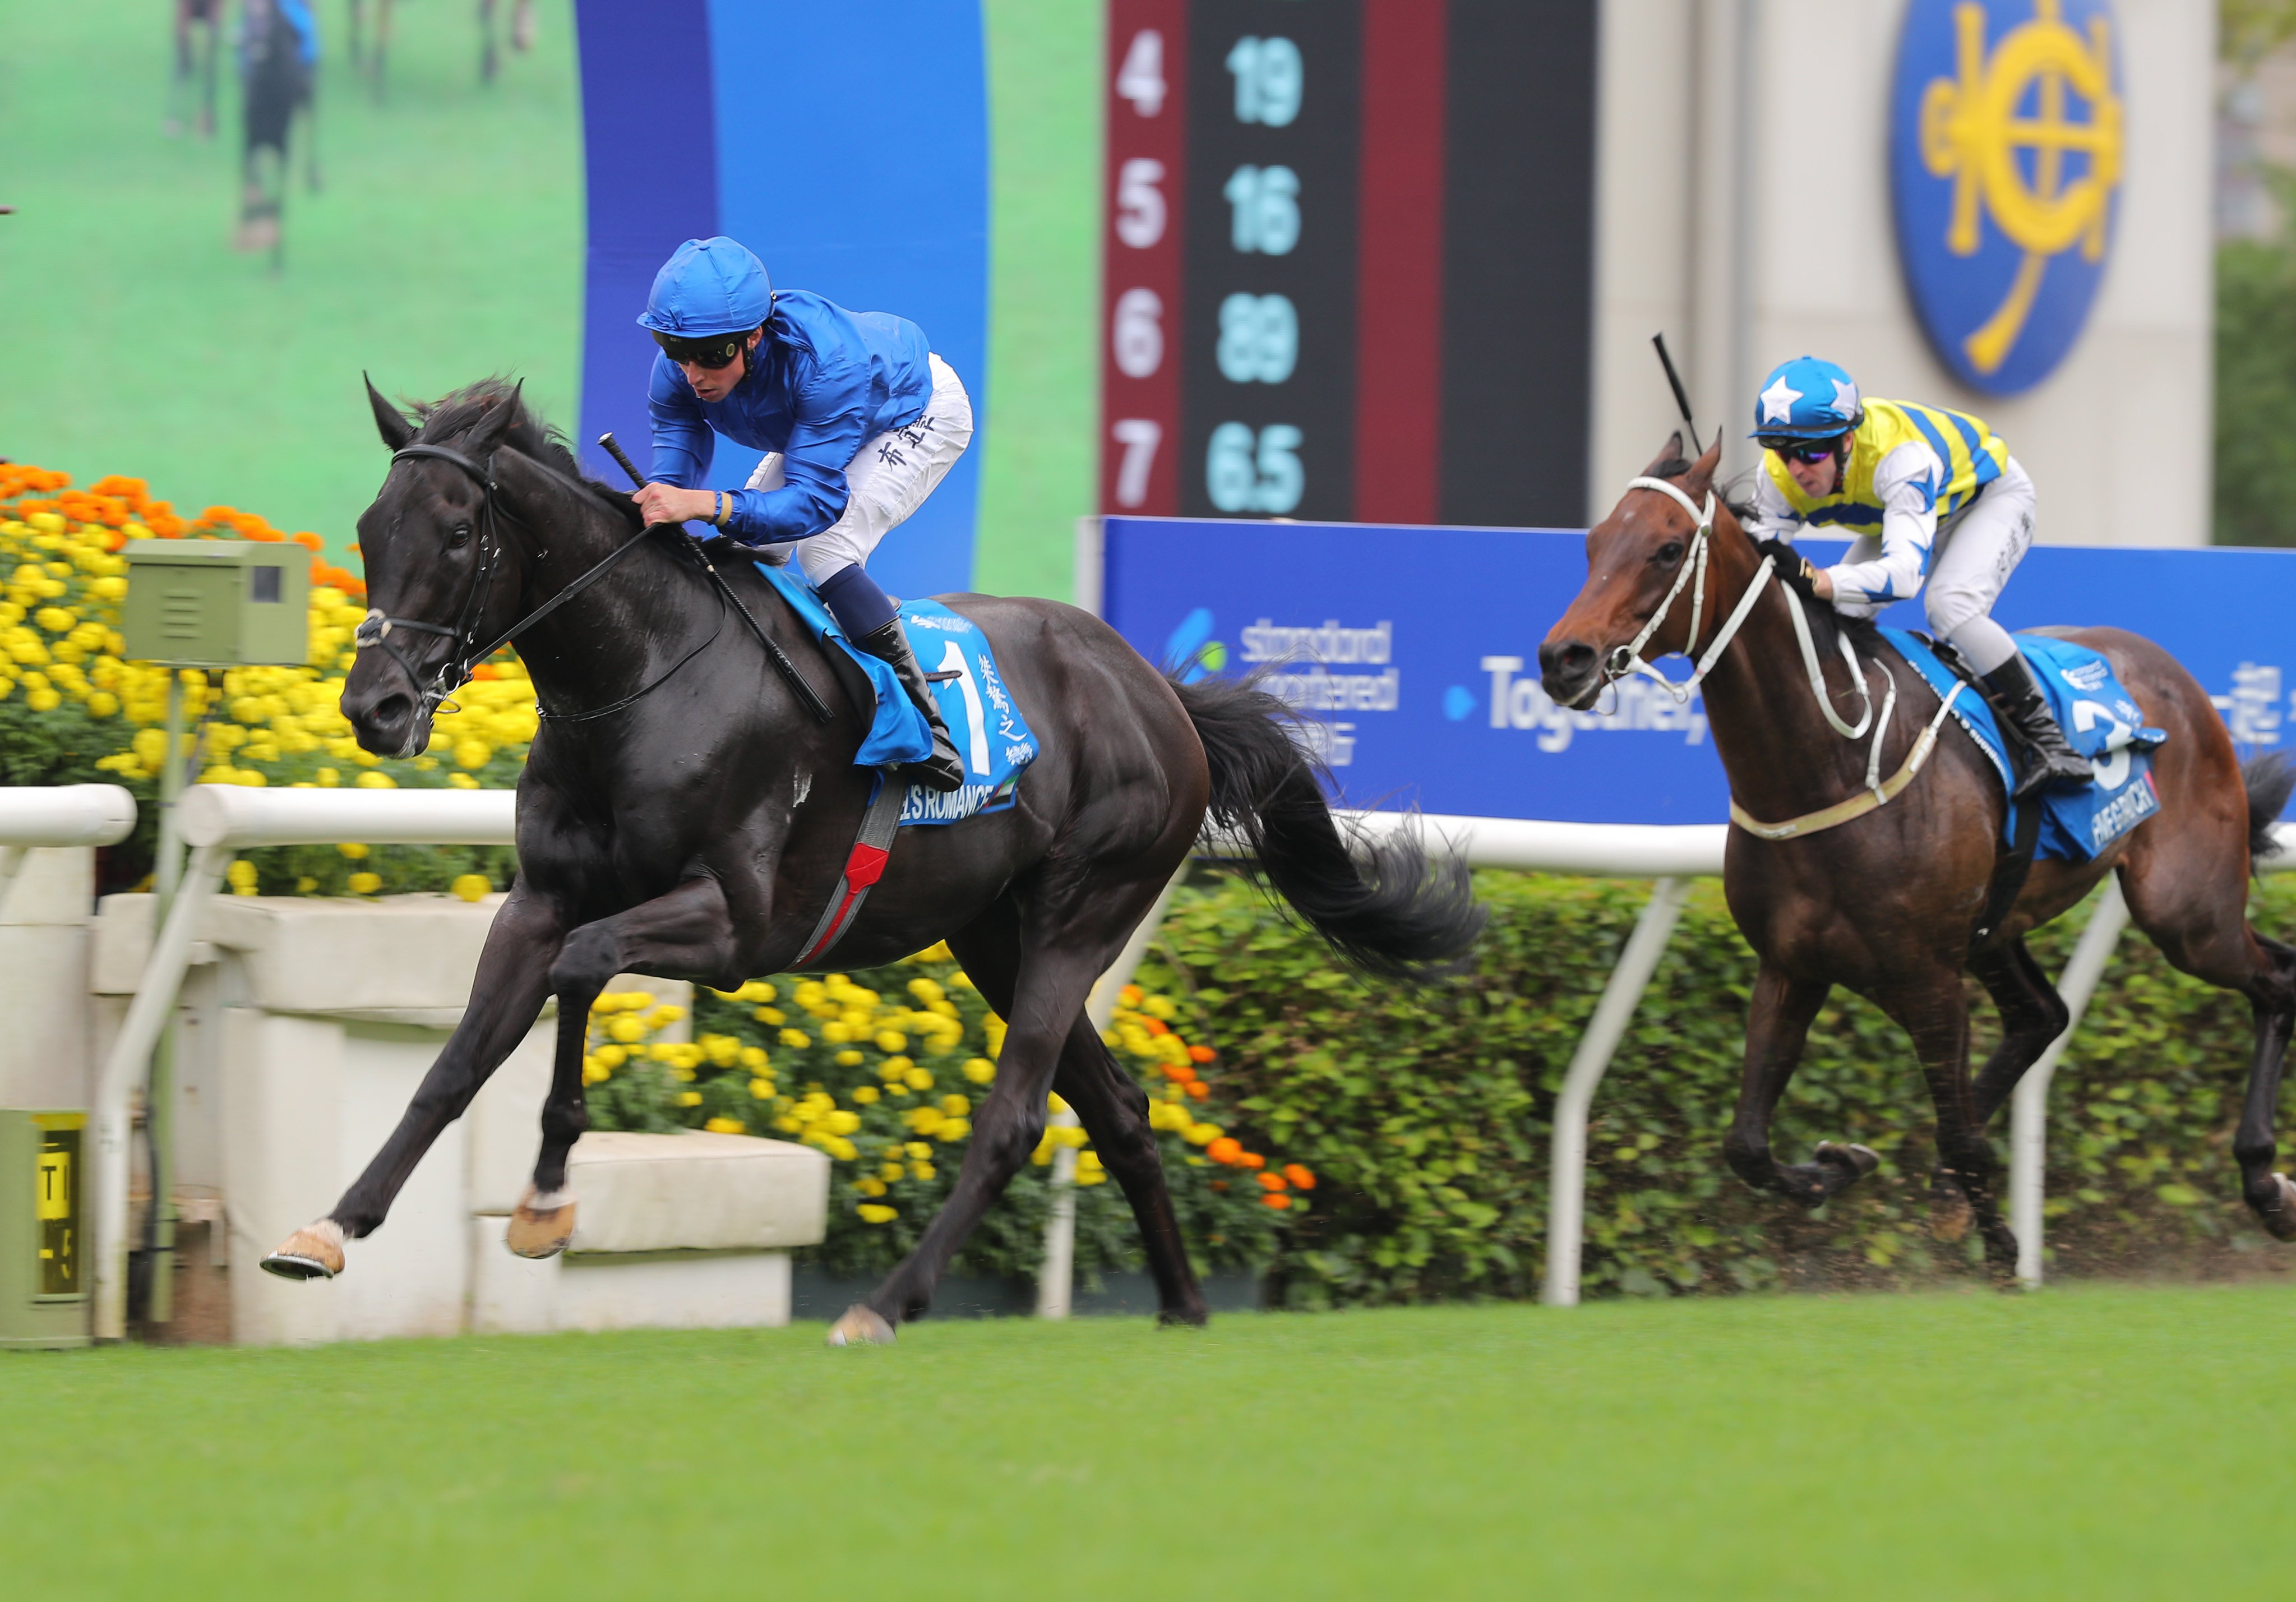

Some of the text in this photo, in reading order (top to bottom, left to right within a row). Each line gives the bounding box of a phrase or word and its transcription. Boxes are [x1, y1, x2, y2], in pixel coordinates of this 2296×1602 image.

[1117, 29, 1303, 128] 4 19
[1116, 158, 1301, 255] 5 16
[1112, 287, 1163, 377] 6
[1112, 418, 1162, 508] 7
[1240, 617, 1392, 664] standard
[937, 640, 991, 777] 1
[2072, 699, 2135, 791] 3
